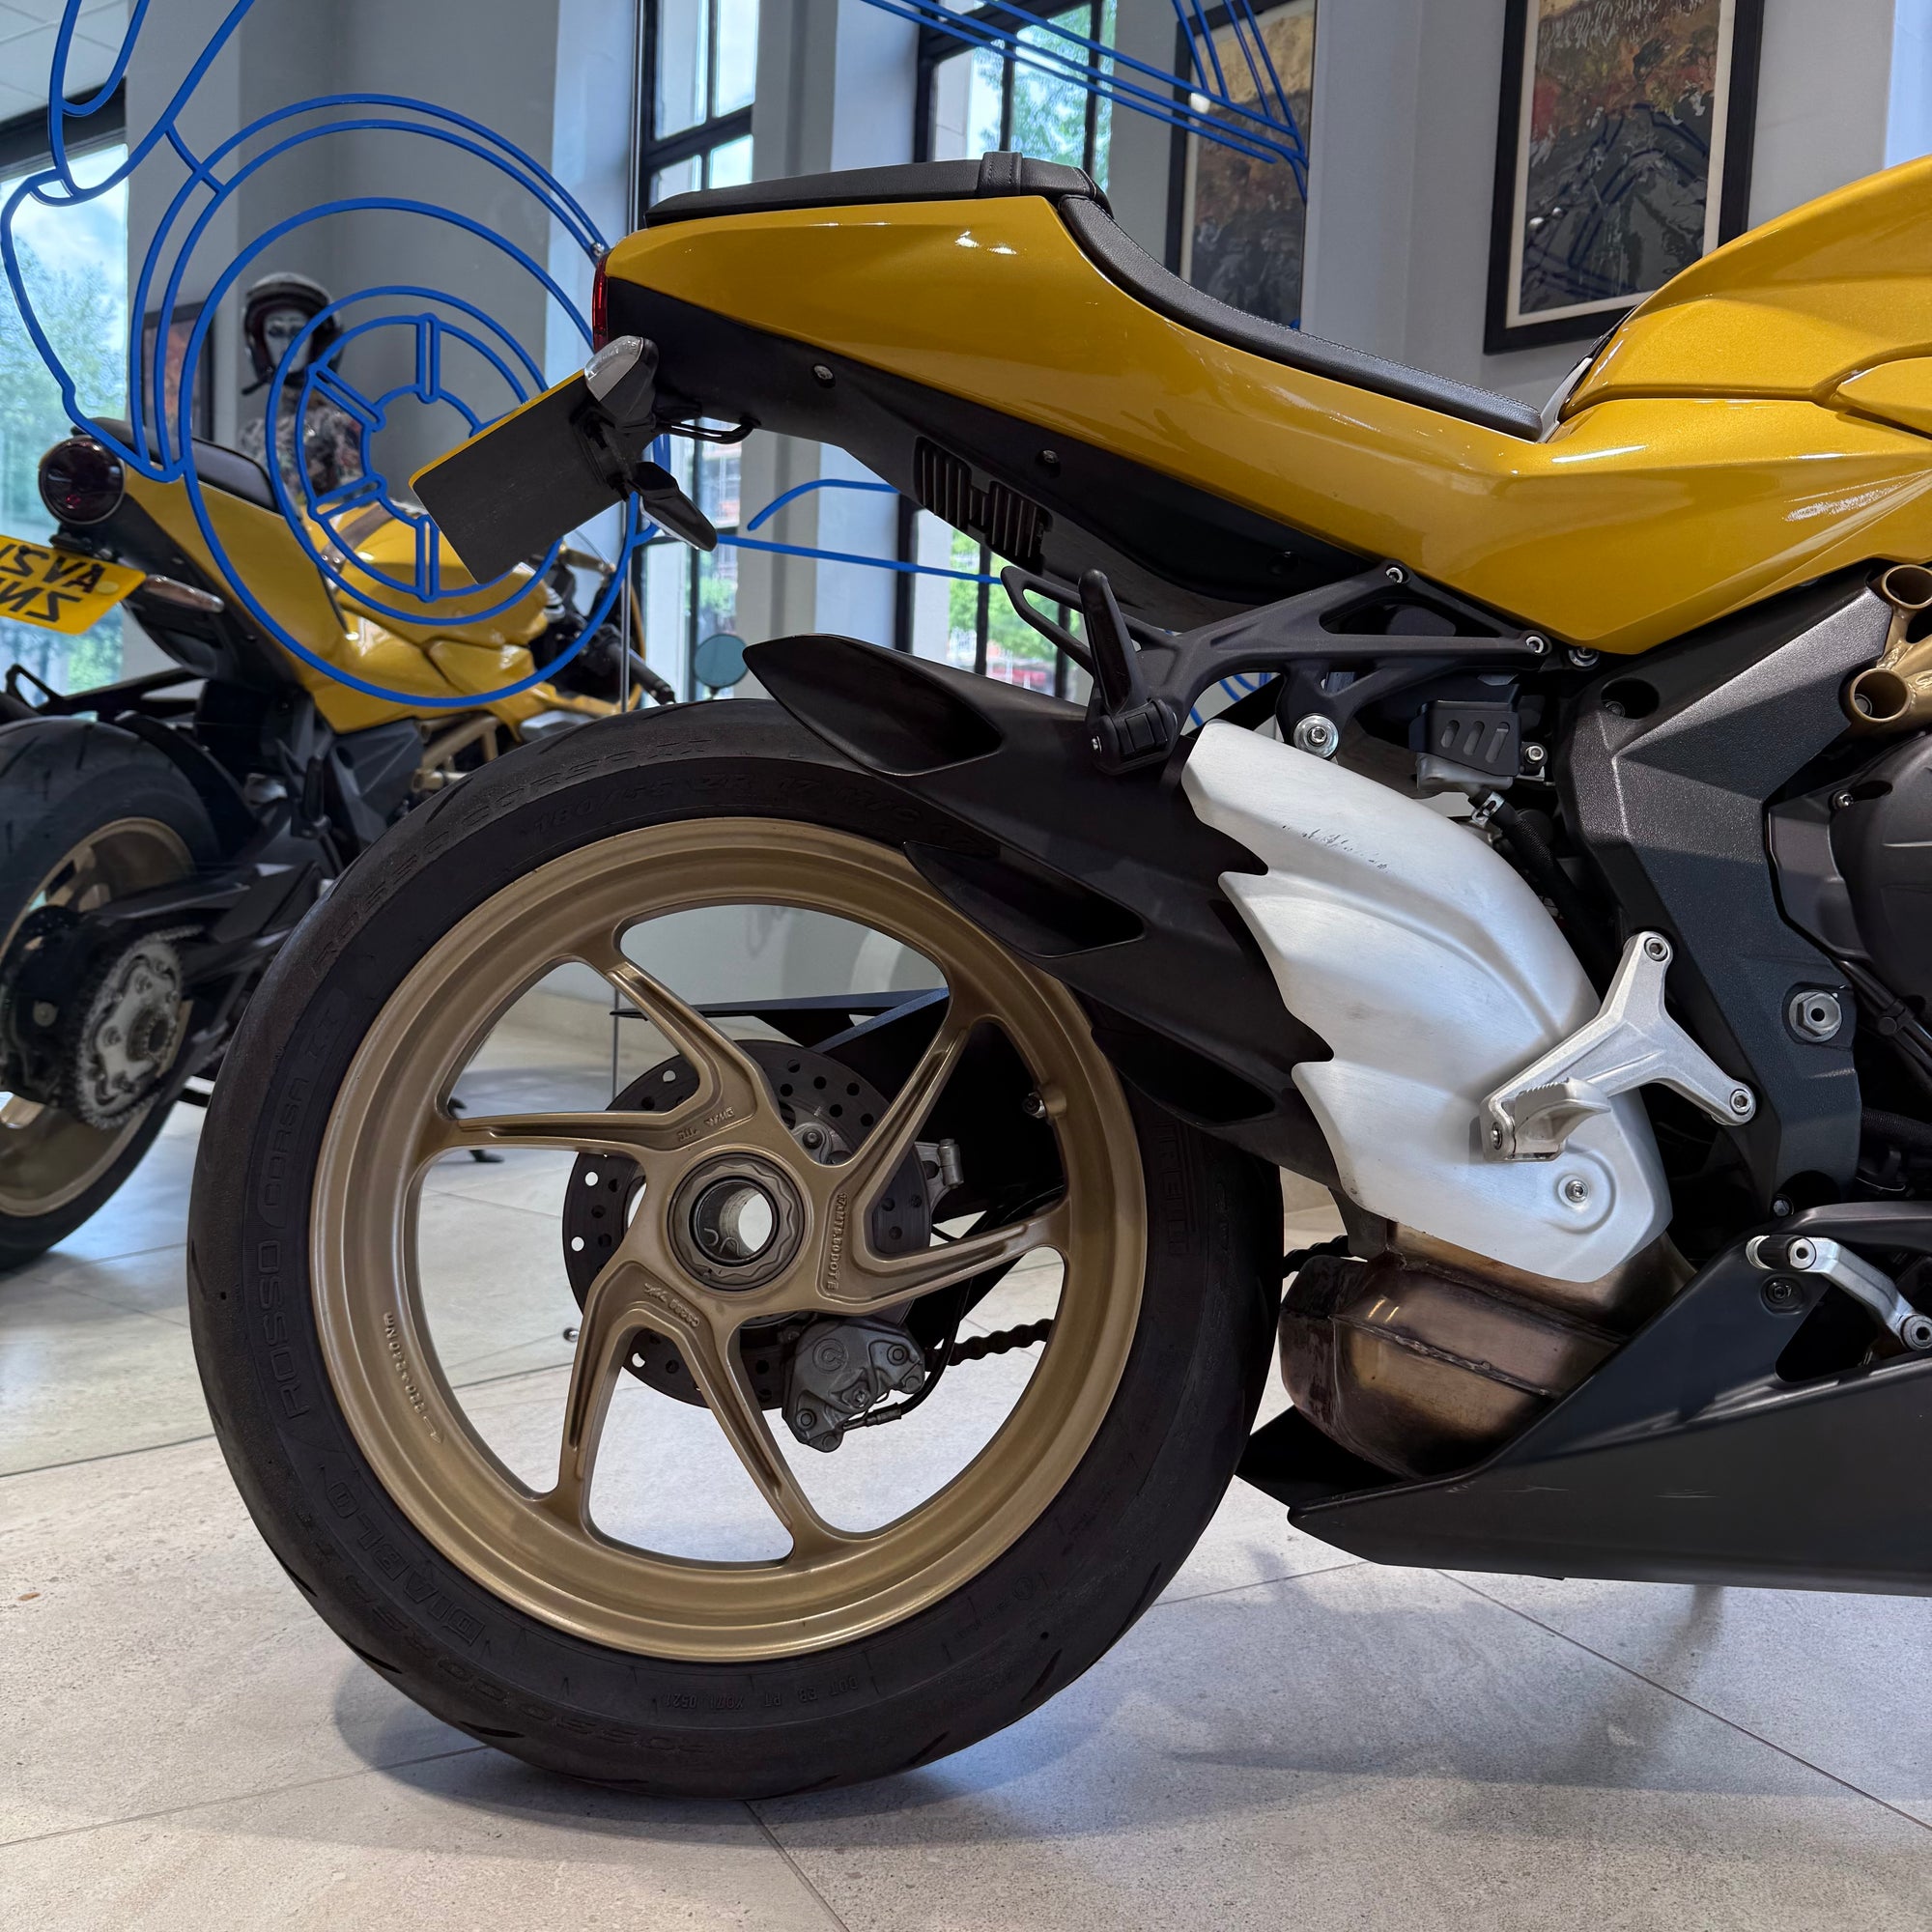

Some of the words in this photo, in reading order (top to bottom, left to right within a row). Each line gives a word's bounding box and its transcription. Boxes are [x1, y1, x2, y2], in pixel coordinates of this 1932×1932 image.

[264, 1075, 310, 1207] CORSA
[258, 1239, 310, 1418] ROSSO
[325, 1478, 487, 1646] DIABLO
[829, 1675, 860, 1696] DOT
